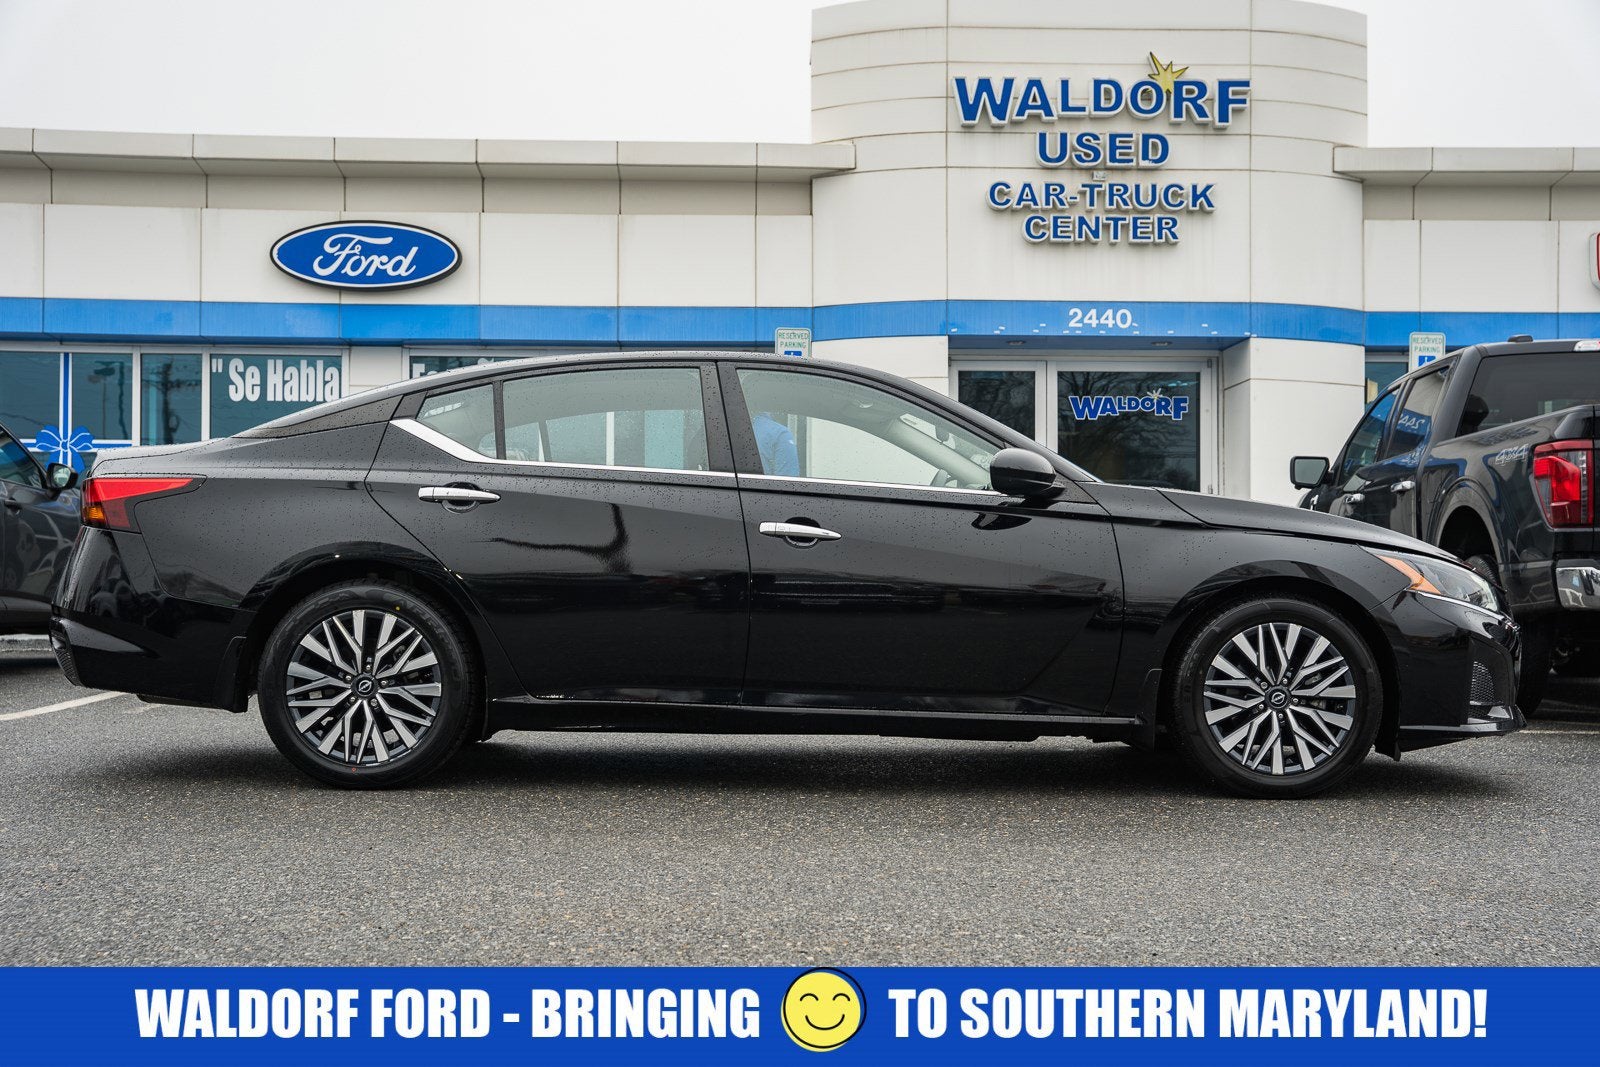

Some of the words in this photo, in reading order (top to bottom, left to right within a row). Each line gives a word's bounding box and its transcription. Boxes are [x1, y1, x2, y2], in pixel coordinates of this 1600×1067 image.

[953, 76, 1251, 128] WALDORF
[1036, 132, 1170, 169] USED
[986, 181, 1217, 213] CAR-TRUCK
[1022, 214, 1180, 244] CENTER
[313, 233, 419, 276] Ford
[1068, 307, 1133, 329] 2440
[778, 331, 809, 340] RESERVED
[779, 341, 807, 349] PARKING
[1412, 336, 1443, 345] RESERVED
[1414, 346, 1441, 354] PARKING
[228, 358, 261, 402] Se
[266, 359, 340, 402] Habla
[1069, 395, 1189, 421] WALDORF
